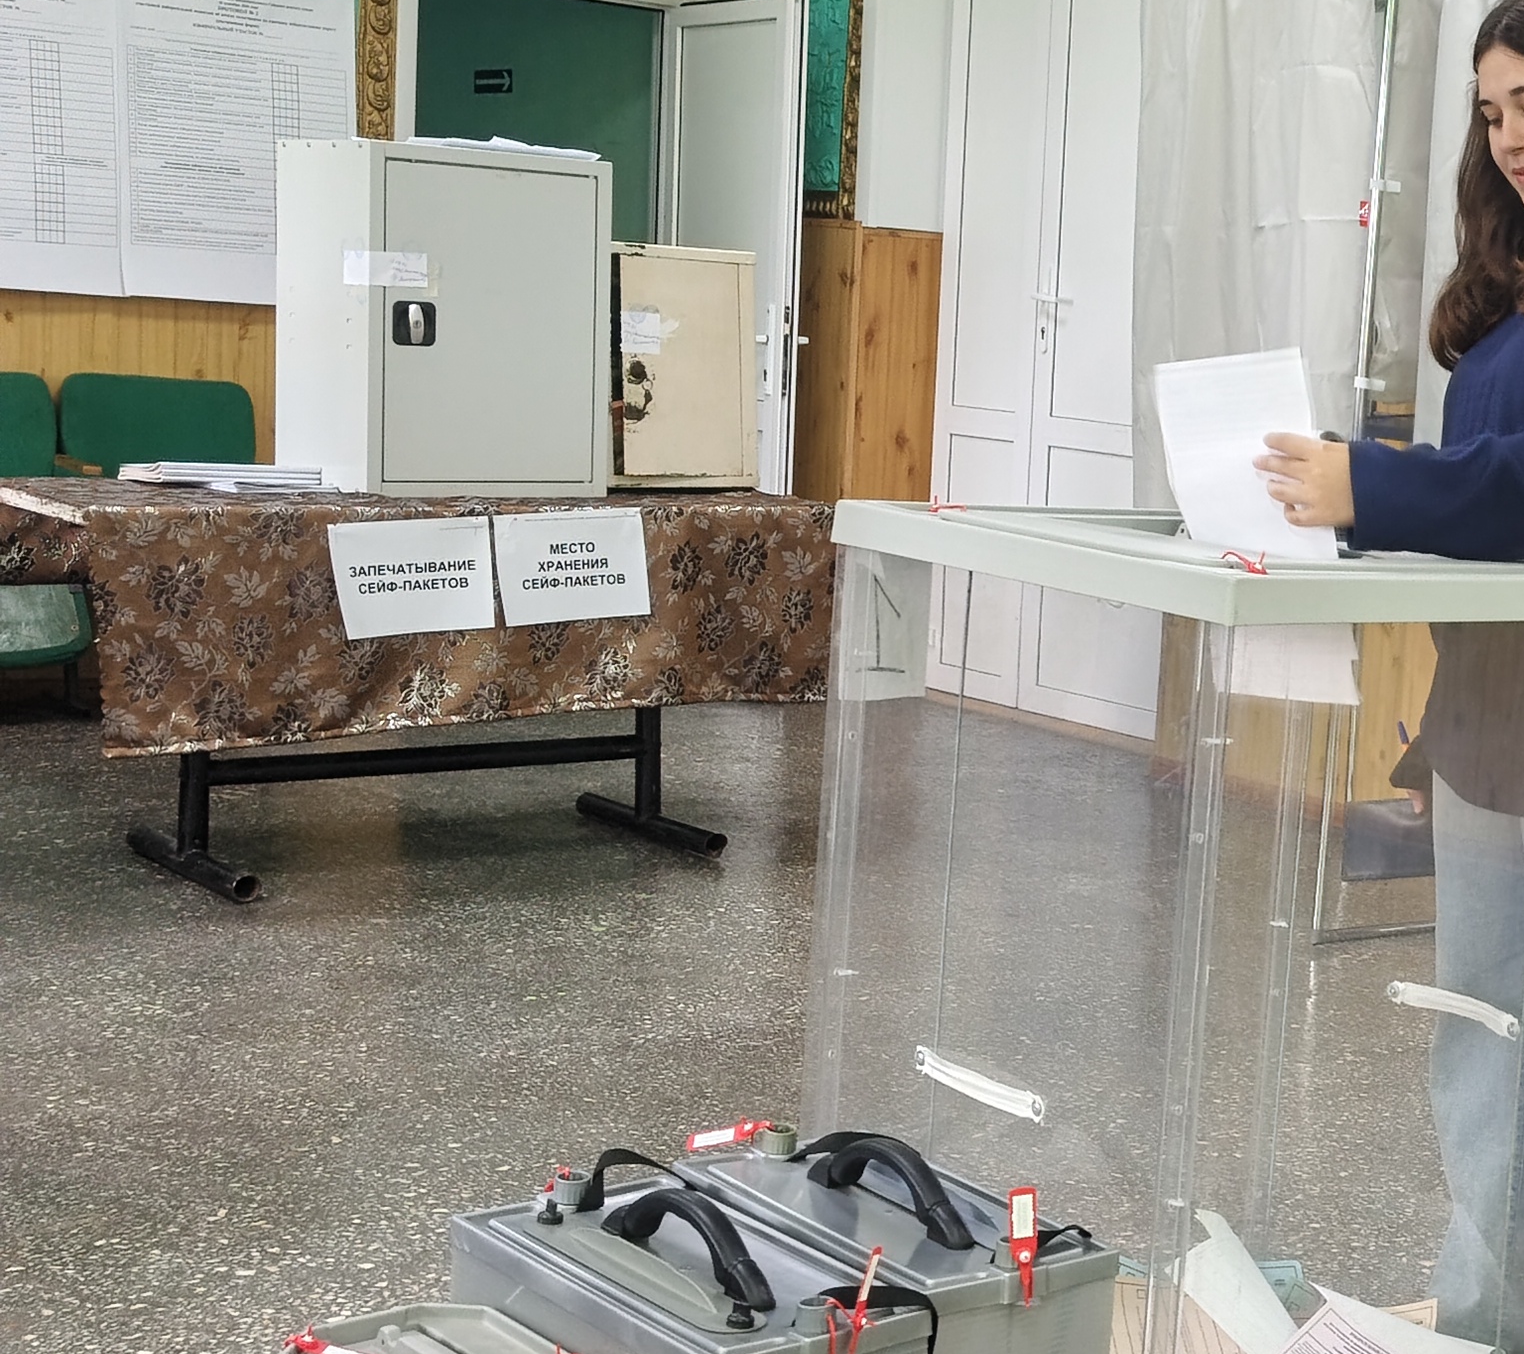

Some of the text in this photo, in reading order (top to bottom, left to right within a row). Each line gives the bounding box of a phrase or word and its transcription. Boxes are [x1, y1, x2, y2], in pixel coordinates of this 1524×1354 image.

[549, 541, 596, 555] МЕСТО
[349, 559, 477, 578] ЗАПЕЧАТЫВАНИЕ
[537, 557, 609, 573] ХРАНЕНИЯ
[358, 576, 470, 595] СЕЙФ-ПАКЕТОВ
[522, 572, 626, 591] СЕЙФ-ПАКЕТОВ
